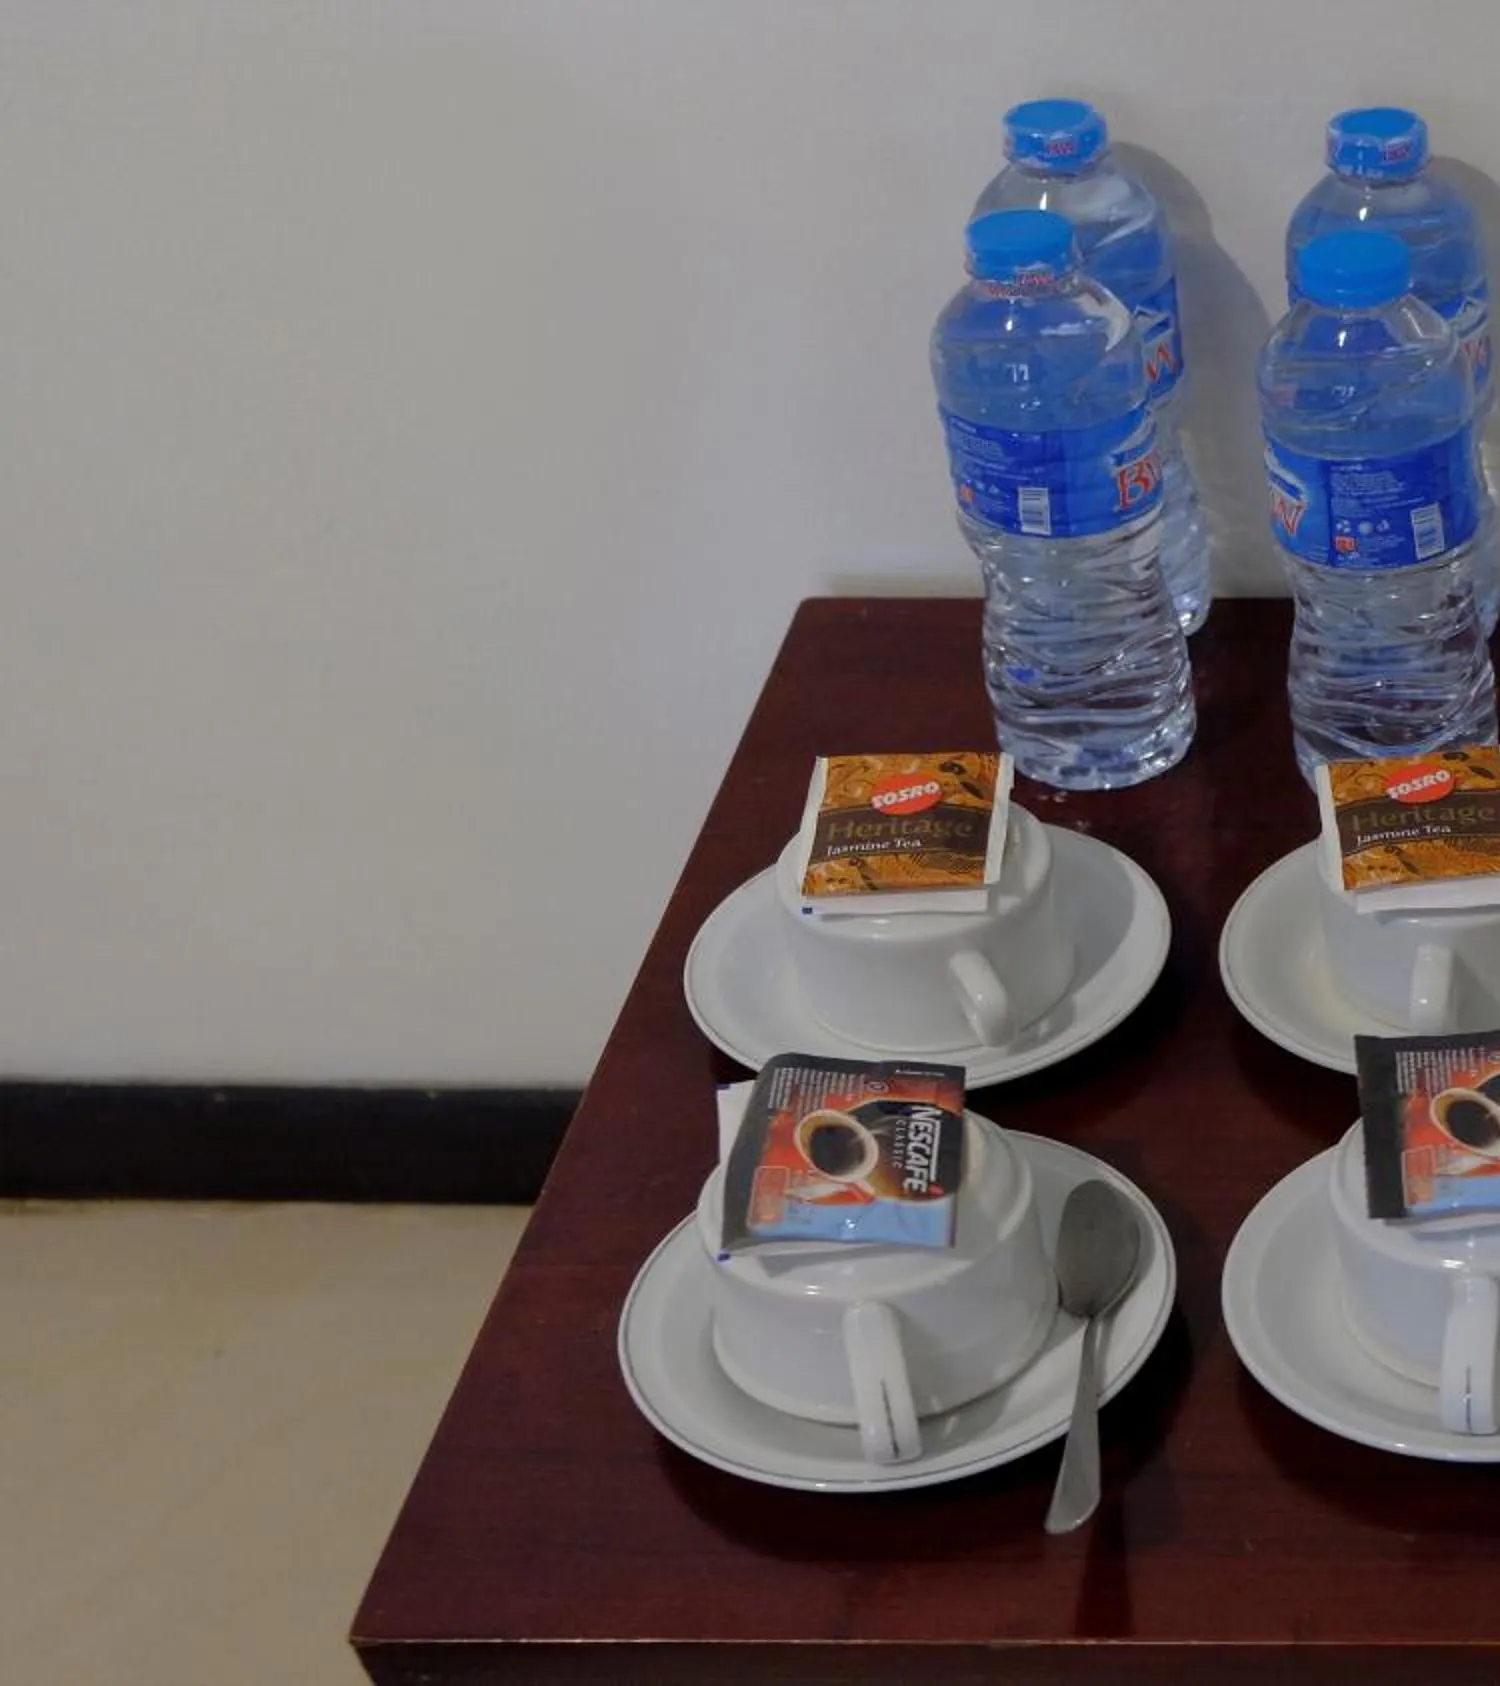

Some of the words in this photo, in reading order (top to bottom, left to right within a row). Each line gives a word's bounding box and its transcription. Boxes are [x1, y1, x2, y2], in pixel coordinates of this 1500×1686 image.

[827, 816, 973, 840] Heritage
[1352, 802, 1497, 832] Heritage
[826, 839, 891, 857] Jasmine
[893, 837, 922, 849] Tea
[1356, 827, 1421, 847] Jasmine
[1423, 824, 1452, 836] Tea
[892, 1118, 904, 1170] CLASSIC
